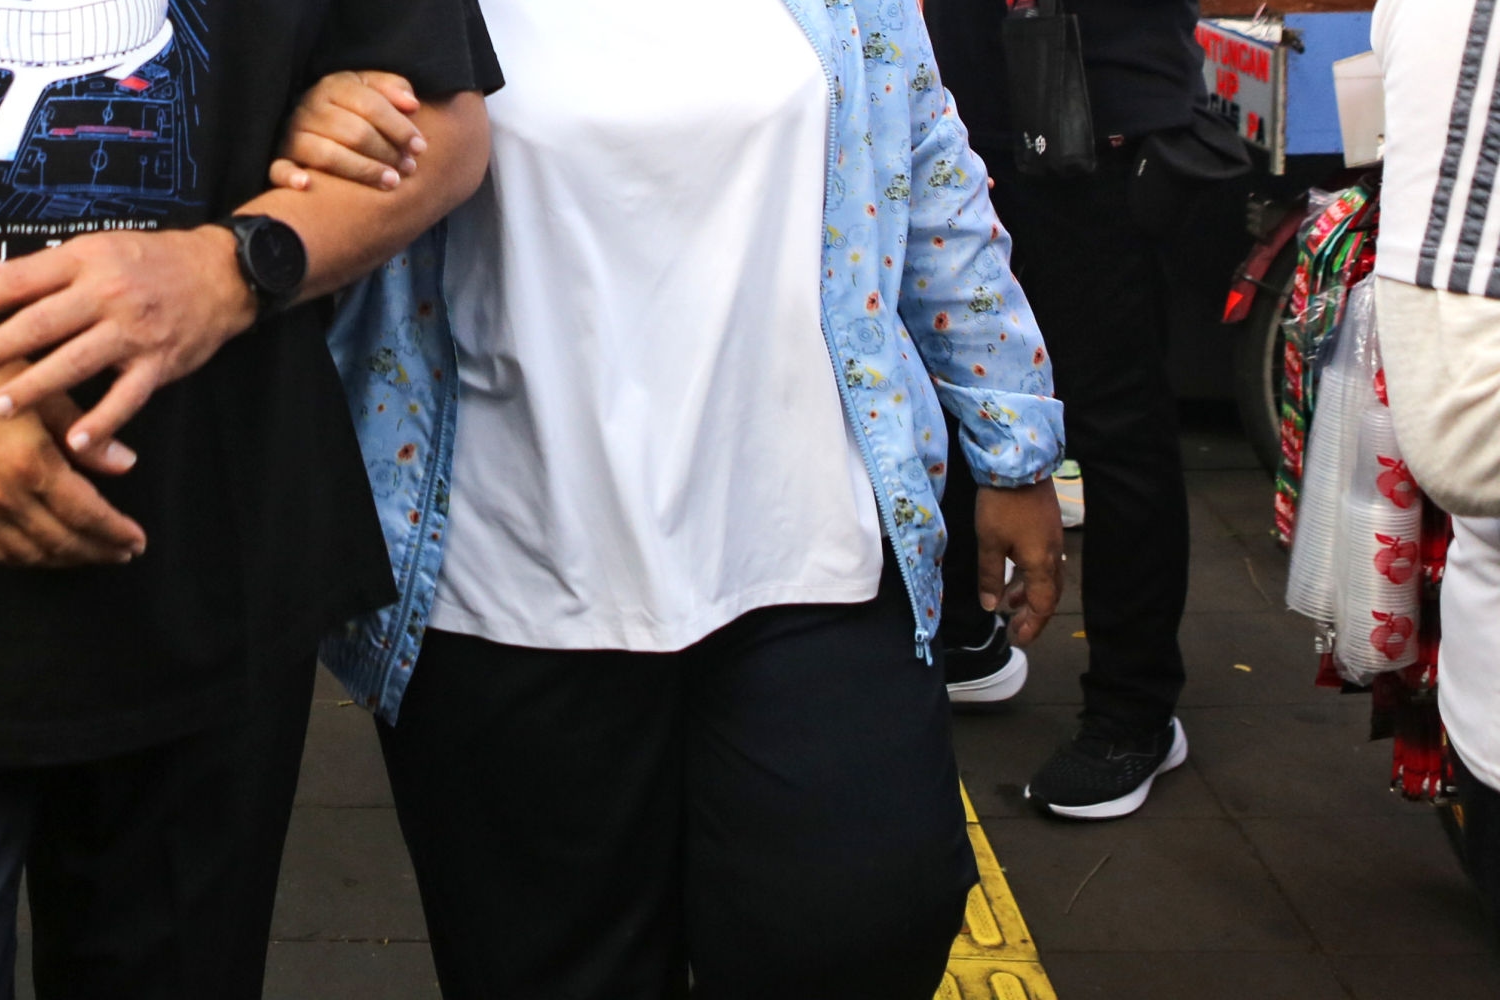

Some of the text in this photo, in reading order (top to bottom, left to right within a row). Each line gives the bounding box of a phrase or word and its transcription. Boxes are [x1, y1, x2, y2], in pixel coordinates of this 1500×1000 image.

[1216, 67, 1240, 102] HP
[6, 222, 99, 236] International
[103, 218, 158, 230] Stadium
